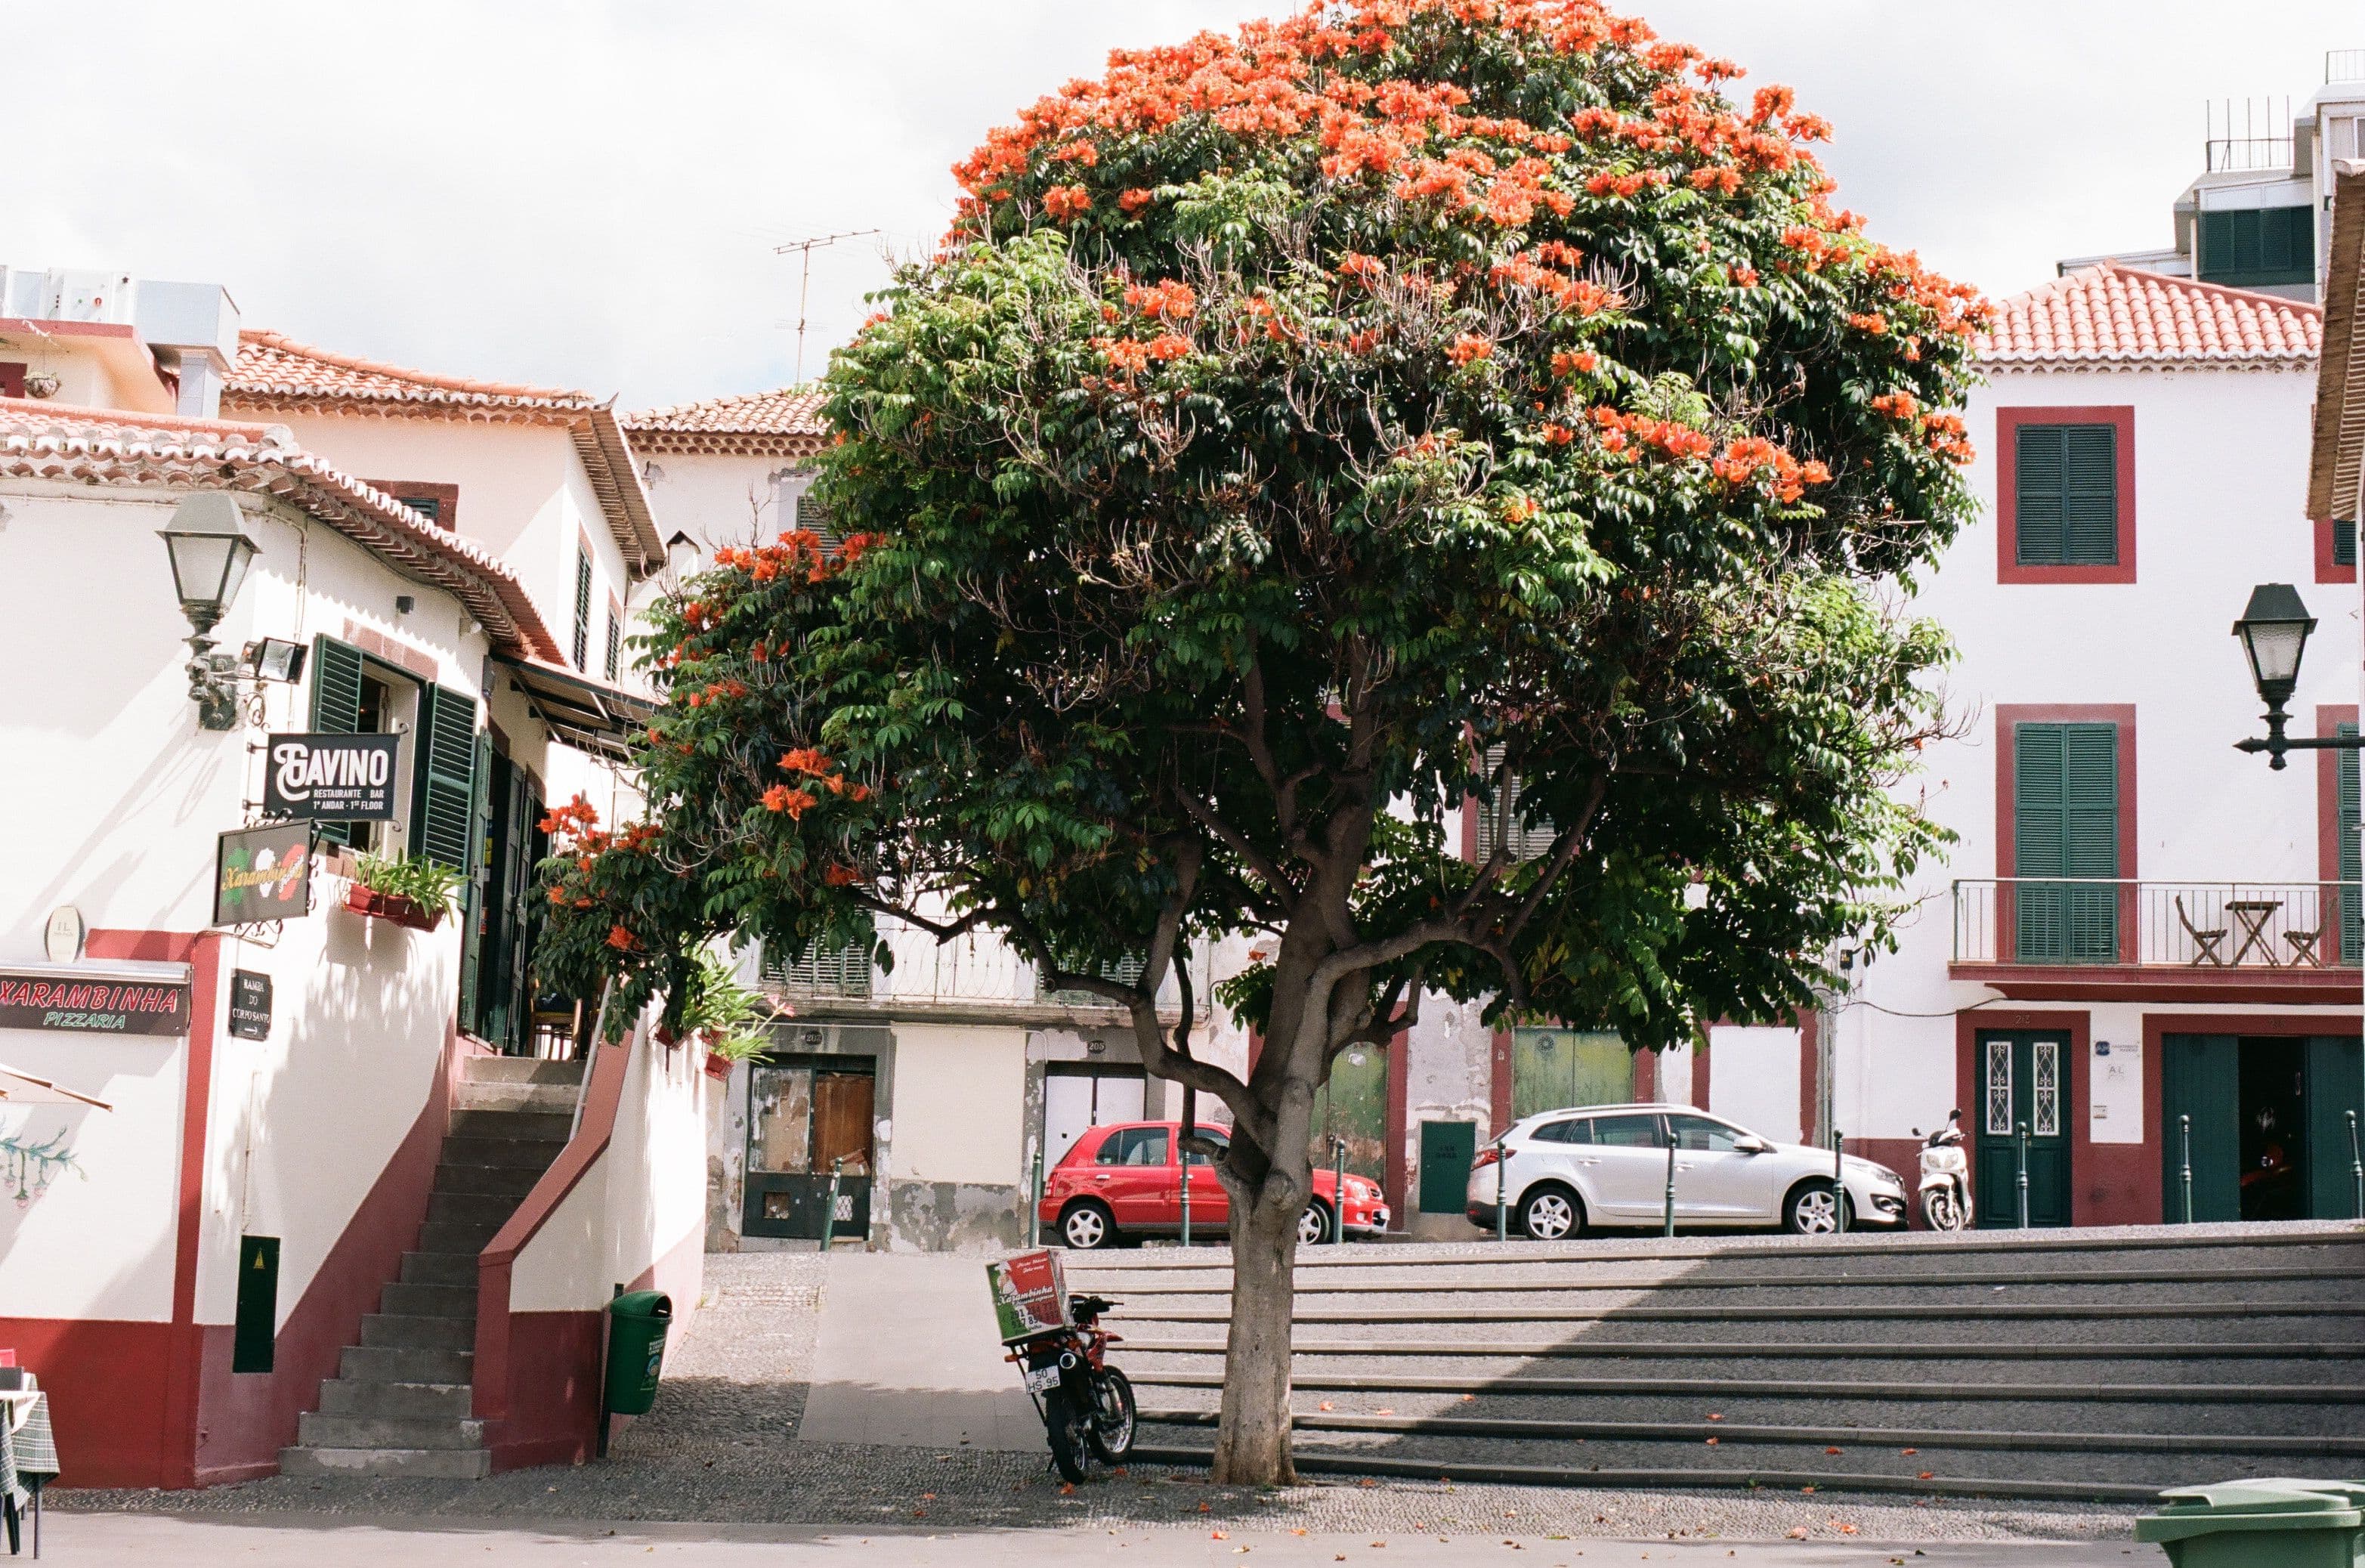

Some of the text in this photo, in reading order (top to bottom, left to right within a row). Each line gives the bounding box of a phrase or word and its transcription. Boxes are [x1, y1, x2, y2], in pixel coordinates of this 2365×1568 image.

[274, 744, 389, 801] GAVINO
[314, 790, 384, 798] RESTAURANTE BAR
[321, 802, 345, 810] ANDAR
[360, 802, 384, 810] FLOOR
[0, 982, 178, 1013] XARAMBINHA
[249, 994, 258, 1005] DO
[43, 1011, 126, 1029] PIZZARIA
[233, 1008, 270, 1024] CORPO SANTO
[1089, 1042, 1105, 1050] 205
[1036, 1369, 1047, 1380] 50
